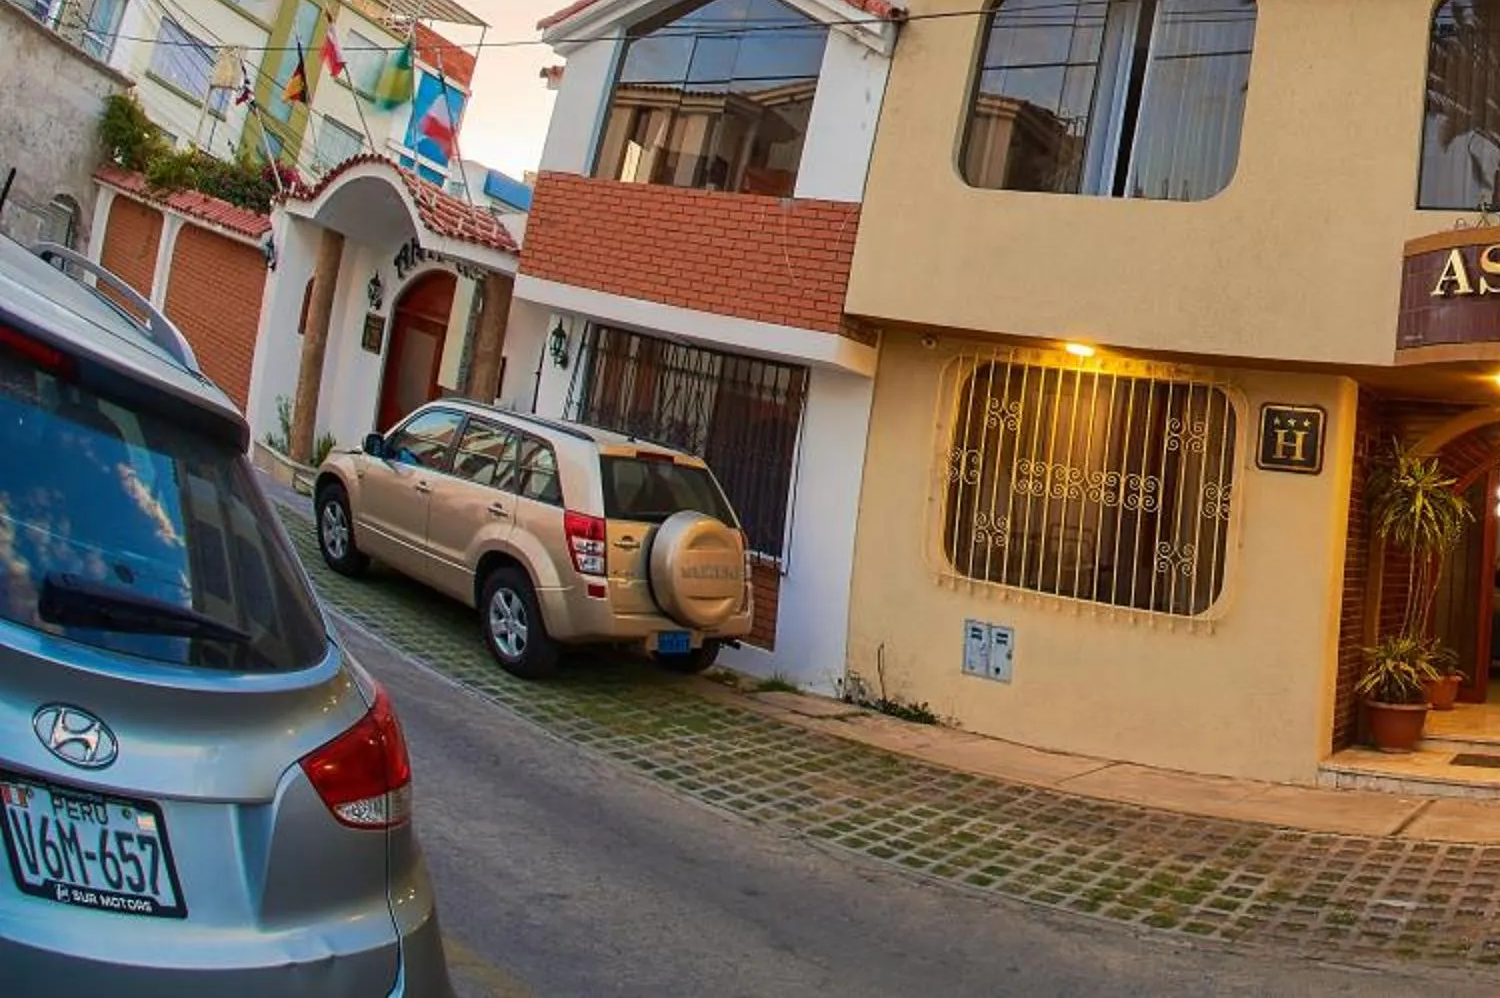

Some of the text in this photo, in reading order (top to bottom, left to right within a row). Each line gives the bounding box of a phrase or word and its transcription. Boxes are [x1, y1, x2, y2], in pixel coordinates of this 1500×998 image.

[1272, 429, 1311, 461] H
[10, 807, 161, 896] V6M-657
[99, 894, 153, 913] MOTORS
